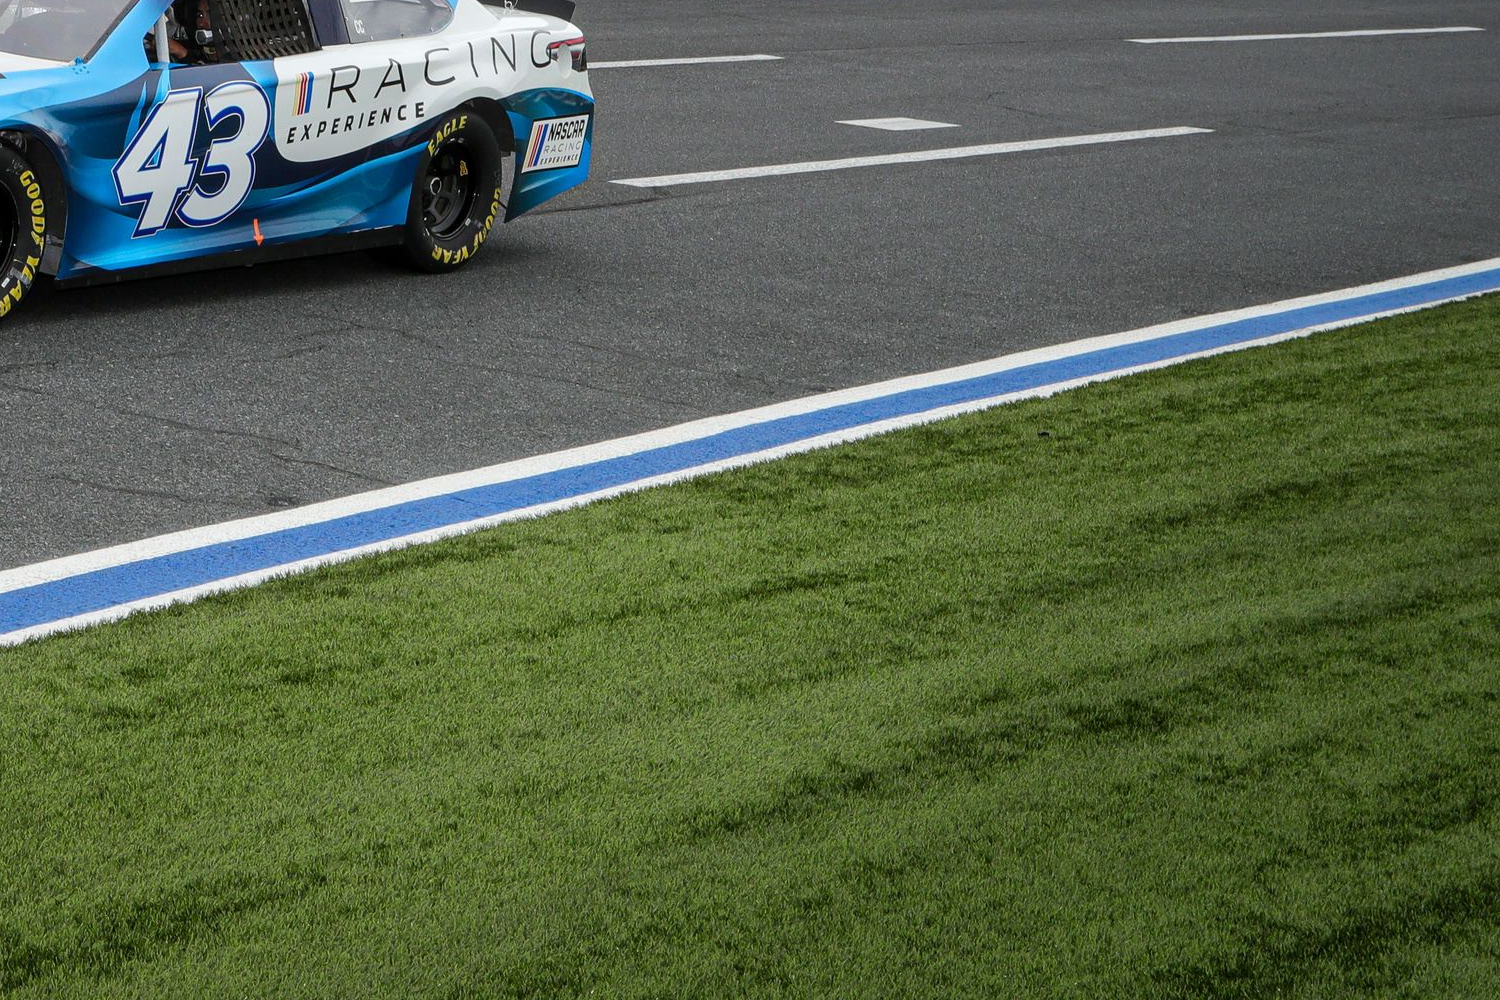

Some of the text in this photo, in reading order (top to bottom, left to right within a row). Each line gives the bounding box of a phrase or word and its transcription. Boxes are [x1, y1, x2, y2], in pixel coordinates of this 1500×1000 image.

[327, 30, 552, 108] RACING
[286, 102, 425, 144] EXPERIENCE
[427, 115, 468, 157] EAGLE
[547, 119, 585, 141] NASCAR
[111, 80, 272, 239] 43
[540, 153, 579, 165] EXPERIENCE
[543, 141, 582, 154] RACING
